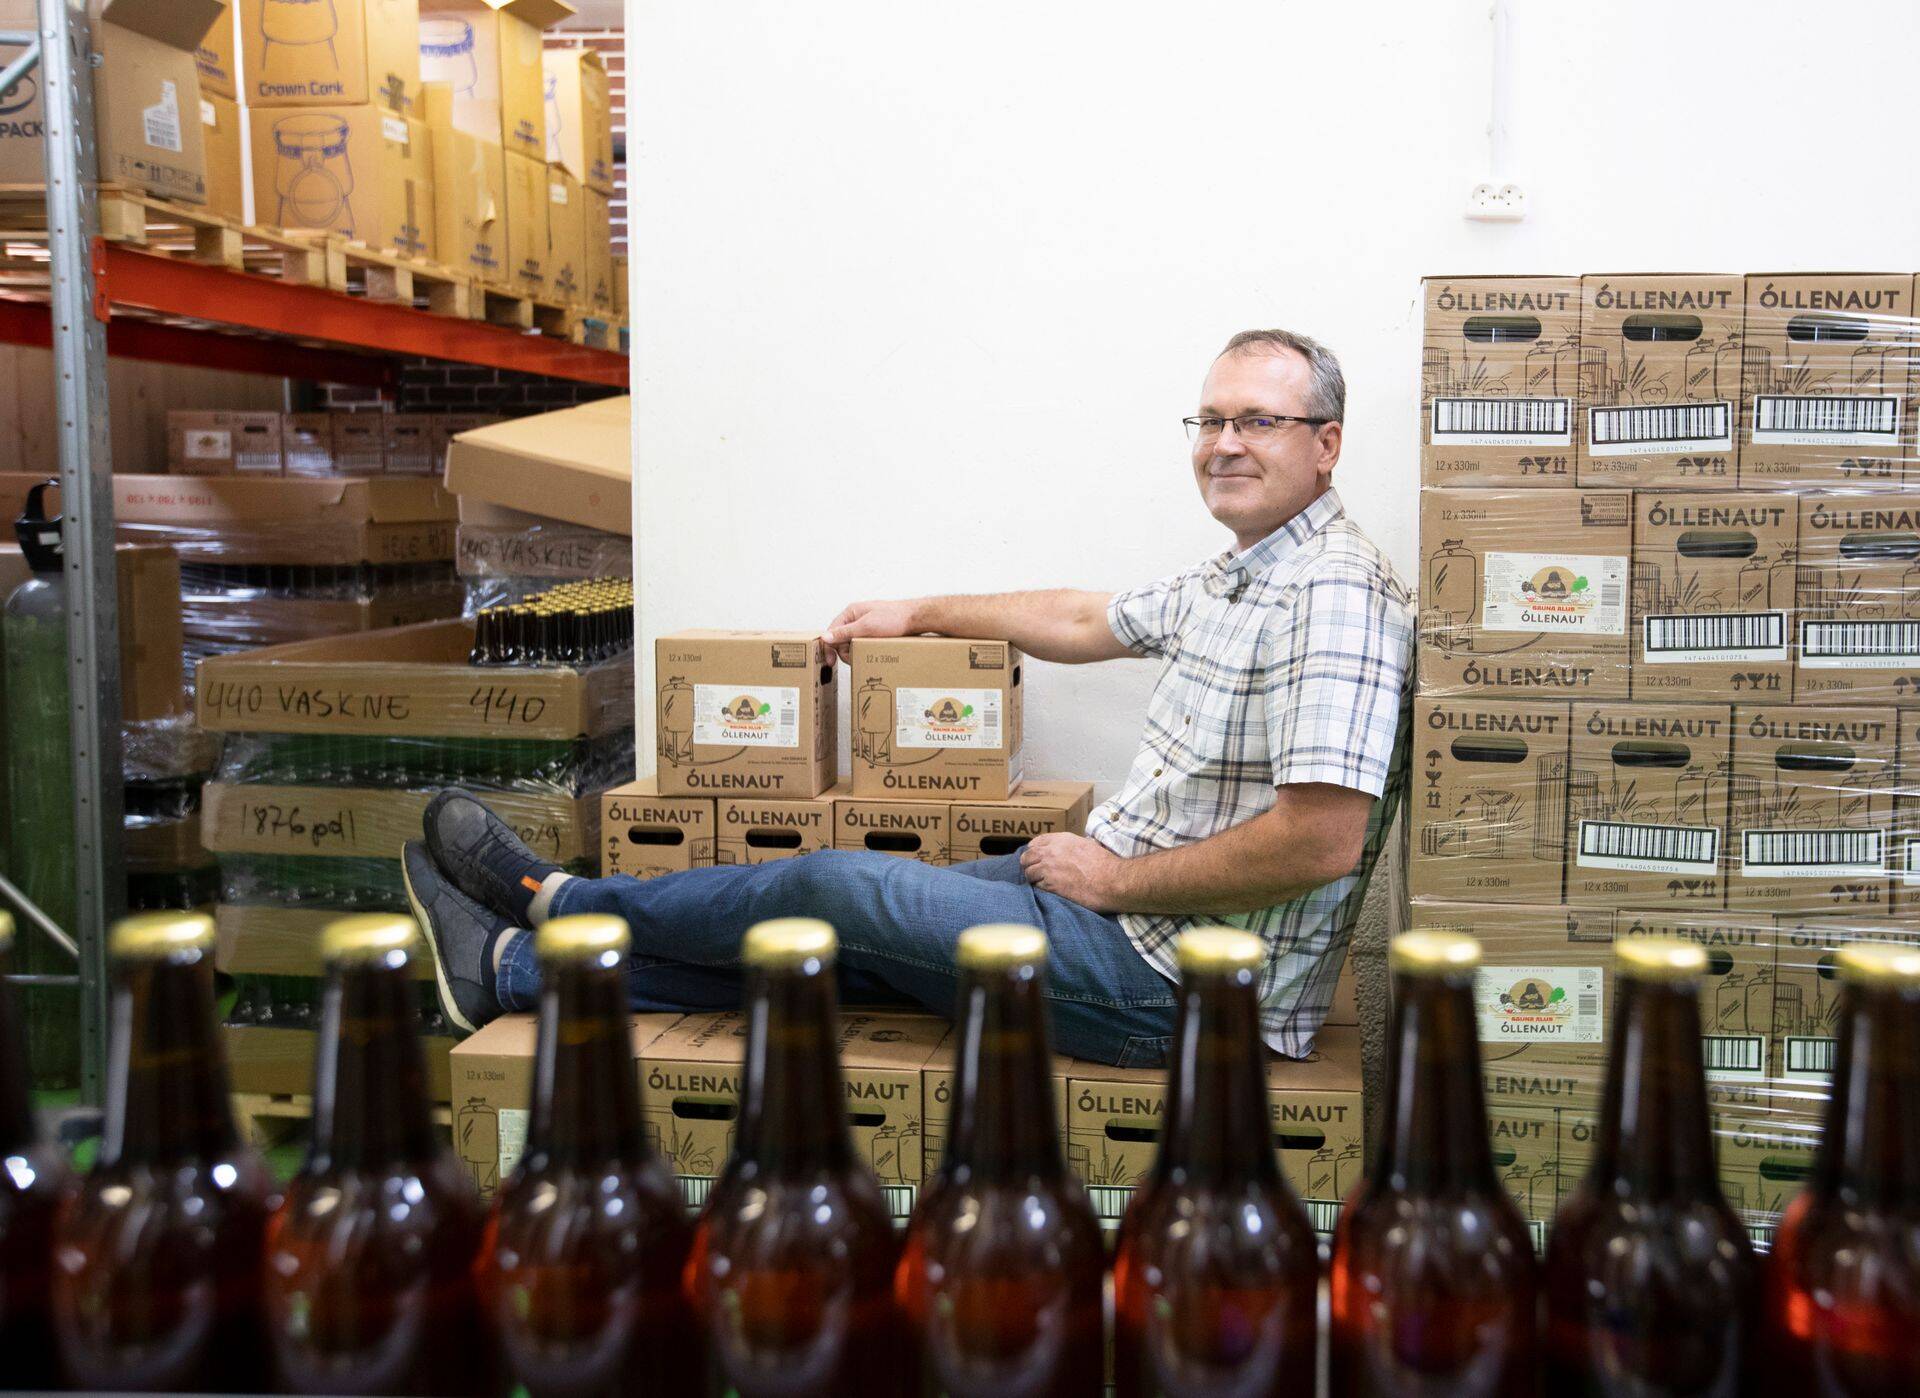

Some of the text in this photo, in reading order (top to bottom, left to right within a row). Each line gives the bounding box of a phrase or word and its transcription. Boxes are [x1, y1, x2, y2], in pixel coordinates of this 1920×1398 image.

[1437, 286, 1569, 311] ÓLLENAUT
[1596, 284, 1732, 310] ÓLLENAUT
[1759, 283, 1900, 309] ÓLLENAUT
[1436, 461, 1445, 470] 12
[1454, 461, 1480, 471] 330ml
[1592, 461, 1602, 471] 12
[1611, 461, 1637, 472] 330ml
[1754, 463, 1764, 473] 12
[1773, 463, 1800, 474] 330ml
[1648, 500, 1785, 527] ÓLLENAUT
[1521, 611, 1585, 624] ÓLLENAUT
[1463, 660, 1594, 686] ÓLLENAUT
[1646, 676, 1656, 686] 12
[1664, 676, 1691, 687] 330ml
[1806, 680, 1817, 689] 12
[1826, 680, 1853, 690] 330ml
[206, 682, 545, 724] 440 VASKNE 440
[1428, 704, 1559, 734] ÓLLENAUT
[1587, 710, 1721, 738] ÓLLENAUT
[1750, 714, 1886, 741] ÓLLENAUT
[722, 729, 768, 739] ÓLLENAUT
[925, 732, 972, 742] ÓLLENAUT
[686, 768, 784, 789] ÓLLENAUT
[883, 769, 981, 790] ÓLLENAUT
[608, 802, 704, 824] ÓLLENAUT
[726, 805, 822, 827] ÓLLENAUT
[844, 808, 942, 830] ÓLLENAUT
[956, 813, 1055, 835] ÓLLENAUT
[1466, 877, 1475, 886] 12
[1484, 877, 1510, 887] 330ml
[1584, 881, 1594, 891] 12
[1602, 881, 1629, 892] 330ml
[1745, 888, 1755, 897] 12
[1764, 888, 1791, 898] 330ml
[1501, 1021, 1563, 1034] ÓLLENAUT
[466, 1071, 474, 1080] 12
[482, 1071, 505, 1081] 330ml
[843, 1081, 909, 1100] NAUT
